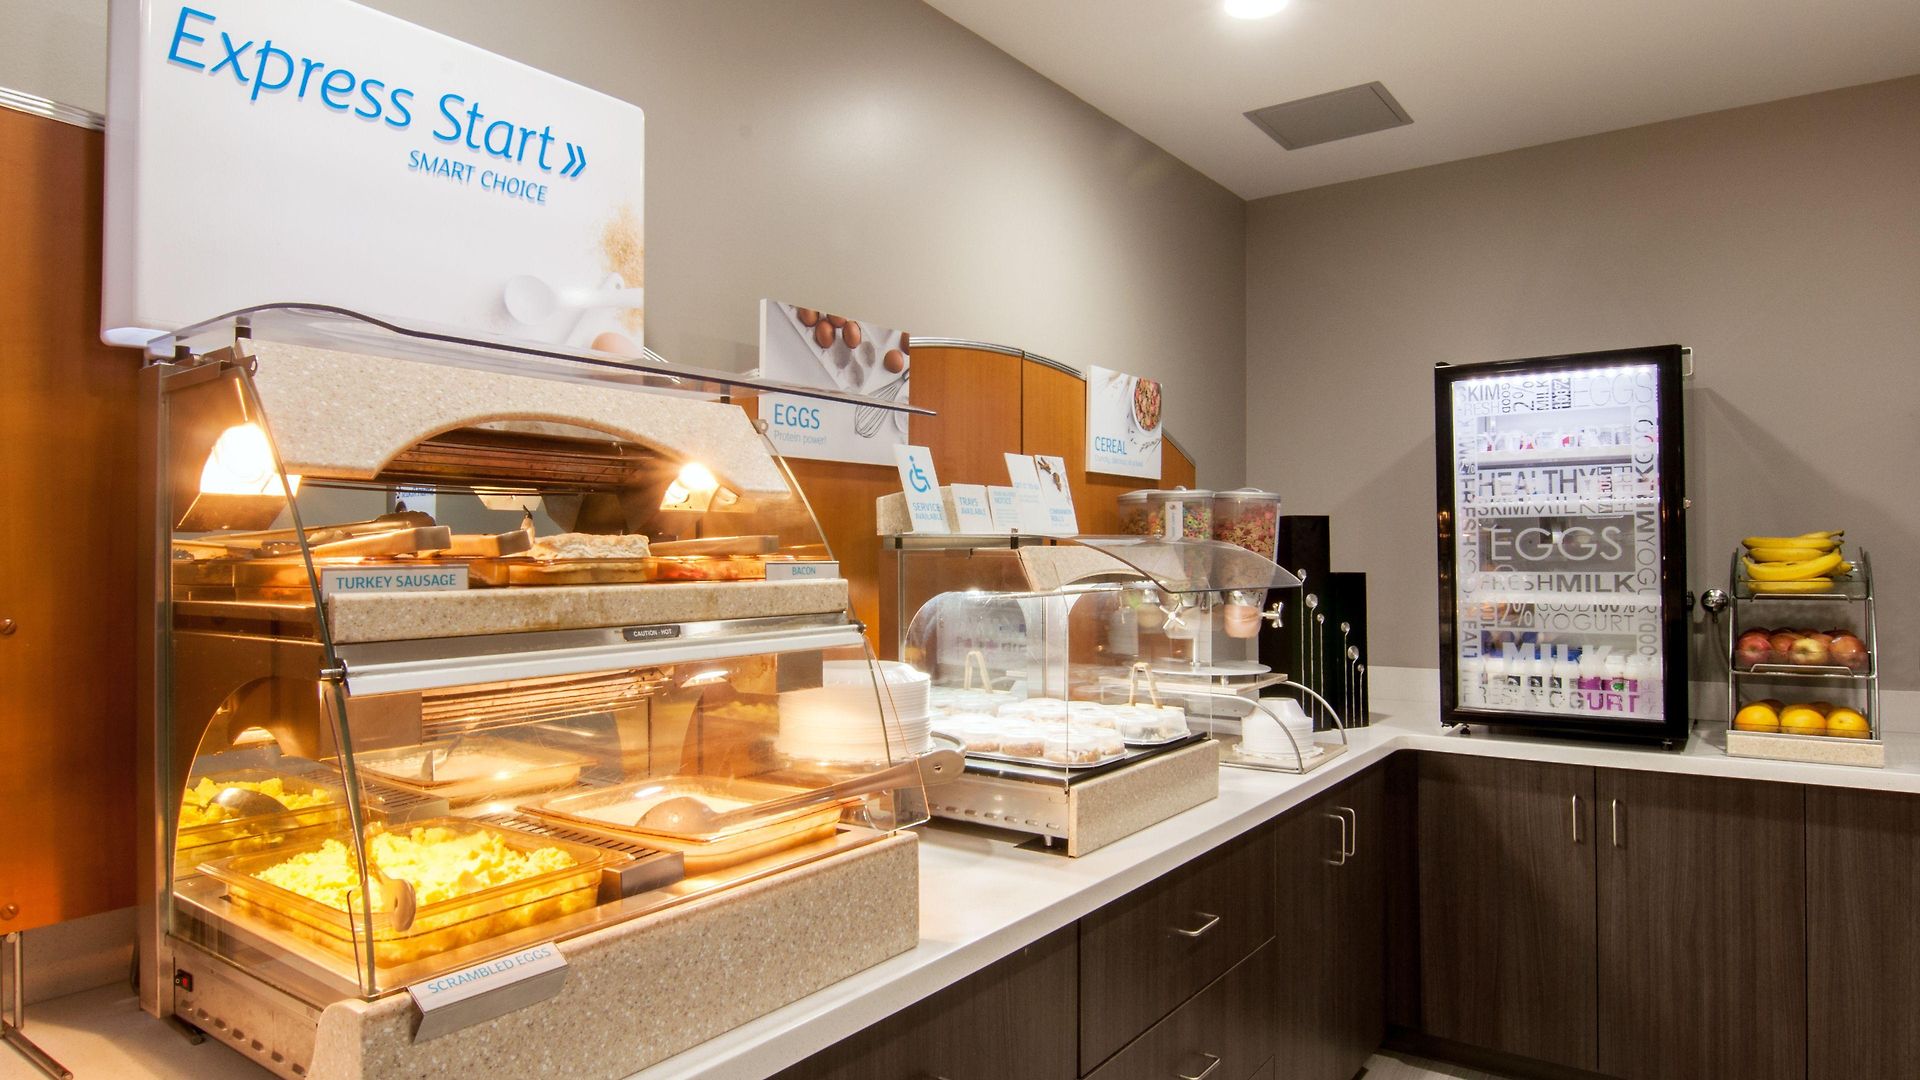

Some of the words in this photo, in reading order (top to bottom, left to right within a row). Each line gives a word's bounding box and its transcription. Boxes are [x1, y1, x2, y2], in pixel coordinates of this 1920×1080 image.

[168, 6, 415, 128] Express
[432, 93, 556, 171] Start
[408, 150, 476, 184] SMART
[480, 170, 549, 204] CHOICE
[1457, 383, 1501, 403] SKIM
[1502, 383, 1511, 414] GOOD
[1512, 380, 1535, 412] 2%
[1536, 380, 1550, 411] MILK
[1573, 373, 1654, 408] EGGS
[774, 403, 820, 430] EGGS
[1095, 436, 1127, 455] CEREAL
[1478, 468, 1597, 498] HEALTHY
[1614, 466, 1634, 513] FREH
[912, 502, 942, 513] SERVICE
[1490, 526, 1624, 561] EGGS
[336, 576, 393, 590] TURKEY
[396, 574, 457, 588] SAUSAGE
[792, 566, 817, 576] BACON
[1556, 573, 1637, 594] MILK
[633, 629, 658, 637] CAUTION
[661, 628, 673, 636] HOT
[1537, 612, 1635, 633] YOGURT
[1502, 641, 1614, 674] MILK
[428, 958, 514, 994] SCRAMBLED
[515, 948, 552, 966] EGGS
